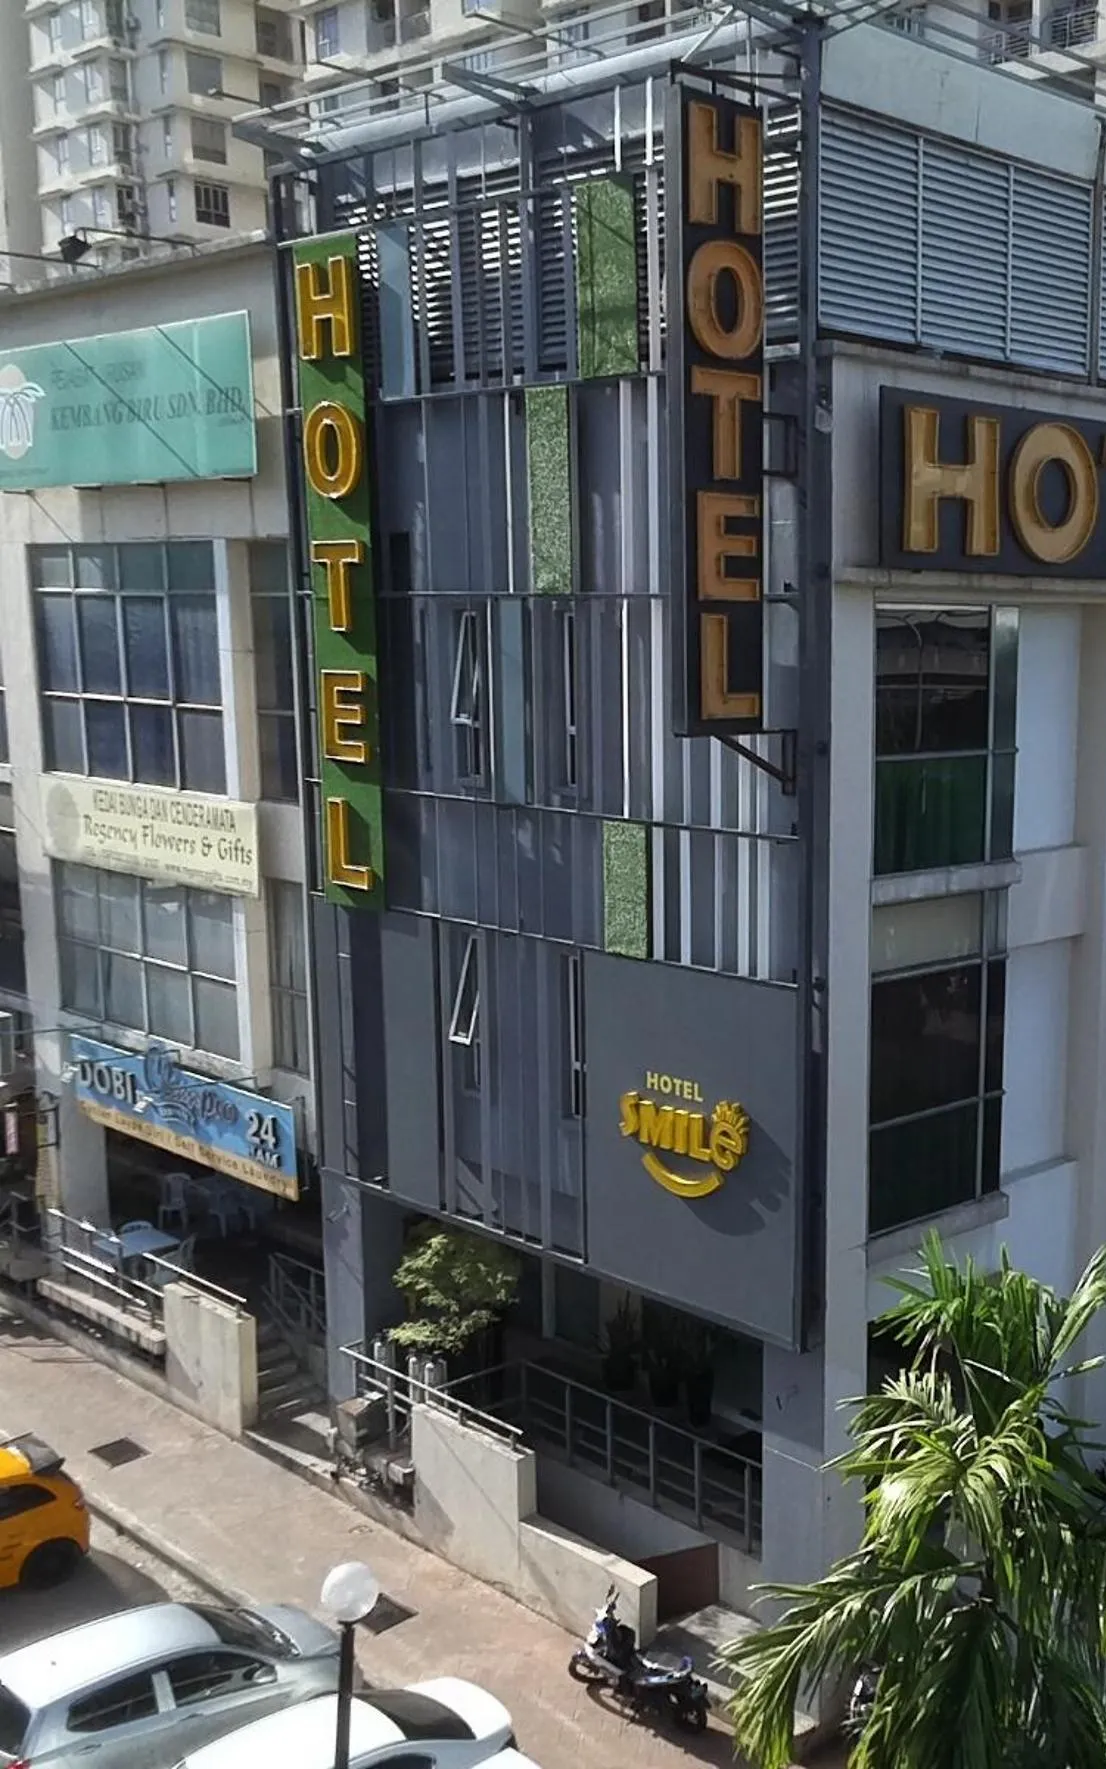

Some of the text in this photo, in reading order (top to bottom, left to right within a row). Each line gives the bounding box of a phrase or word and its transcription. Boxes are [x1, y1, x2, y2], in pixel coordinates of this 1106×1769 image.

[686, 104, 763, 720] HOTEL
[295, 254, 373, 892] HOTEL
[83, 814, 253, 866] Regency Flowers & Gifts
[77, 1055, 135, 1104] DOBI
[646, 1071, 704, 1102] HOTEL
[245, 1109, 278, 1151] 24
